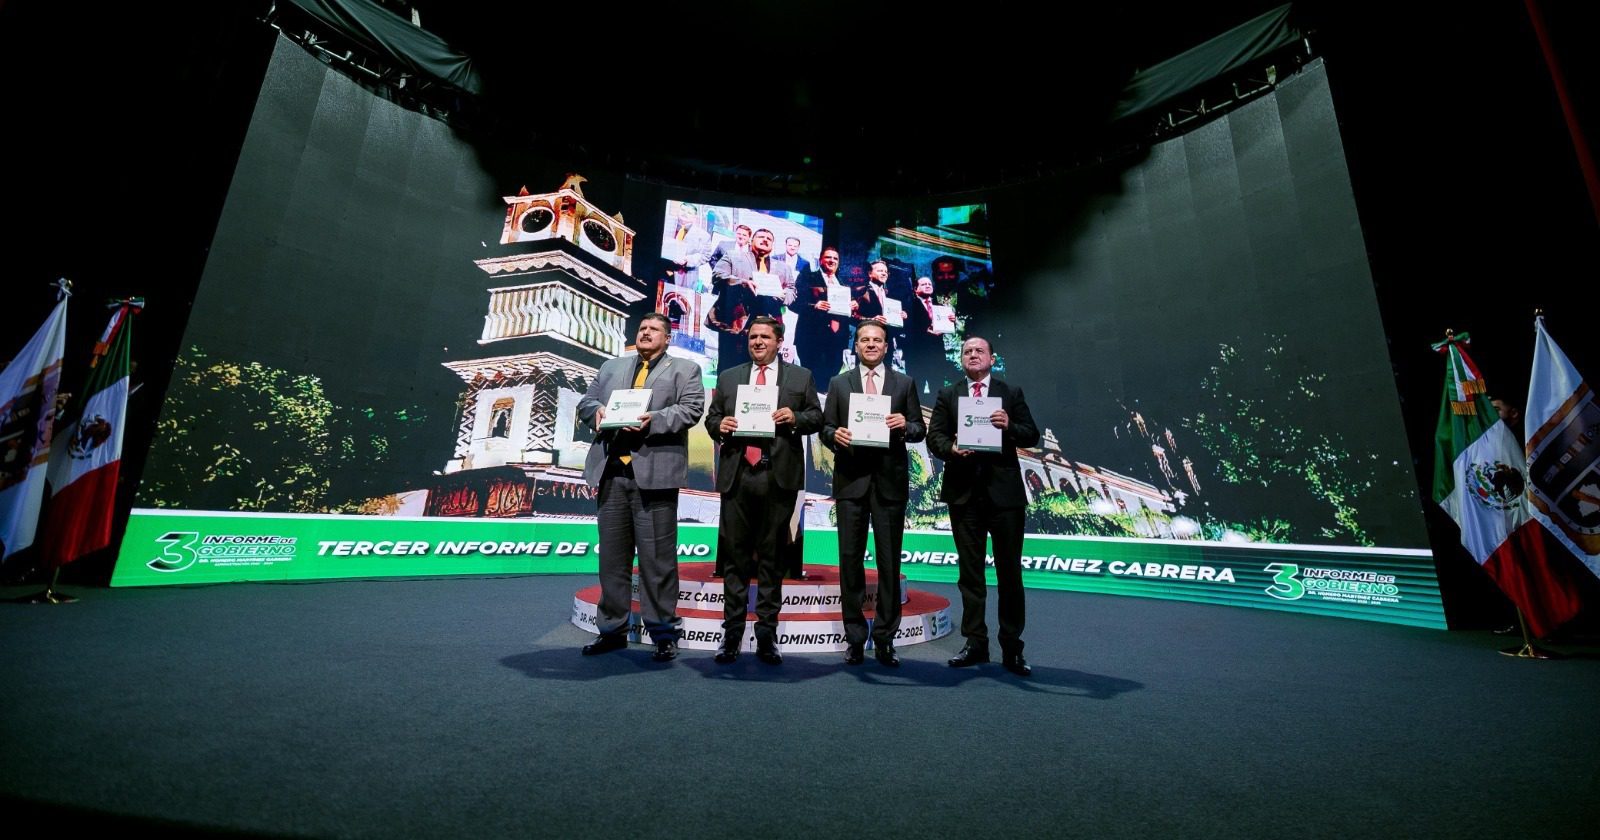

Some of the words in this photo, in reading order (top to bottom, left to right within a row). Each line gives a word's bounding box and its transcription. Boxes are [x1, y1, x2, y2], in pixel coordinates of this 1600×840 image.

[741, 402, 750, 414] 3
[854, 410, 864, 423] 3
[963, 414, 974, 427] 3
[202, 535, 279, 545] INFORME
[279, 537, 297, 545] DE
[146, 531, 199, 573] 3
[197, 545, 297, 556] GOBIERNO
[317, 541, 429, 556] TERCER
[434, 541, 551, 555] INFORME
[555, 541, 589, 555] DE
[901, 550, 960, 564] OMER
[985, 554, 1103, 573] MRTÍNEZ
[1108, 561, 1236, 583] CABRERA
[1263, 562, 1305, 601] 3
[1303, 568, 1376, 582] INFORME
[1377, 575, 1395, 583] DE
[1302, 577, 1399, 595] GOBIERNO
[694, 592, 724, 604] CABR
[680, 630, 723, 643] ABRER
[775, 633, 848, 645] DMINISTRA
[893, 626, 923, 639] 2-2025
